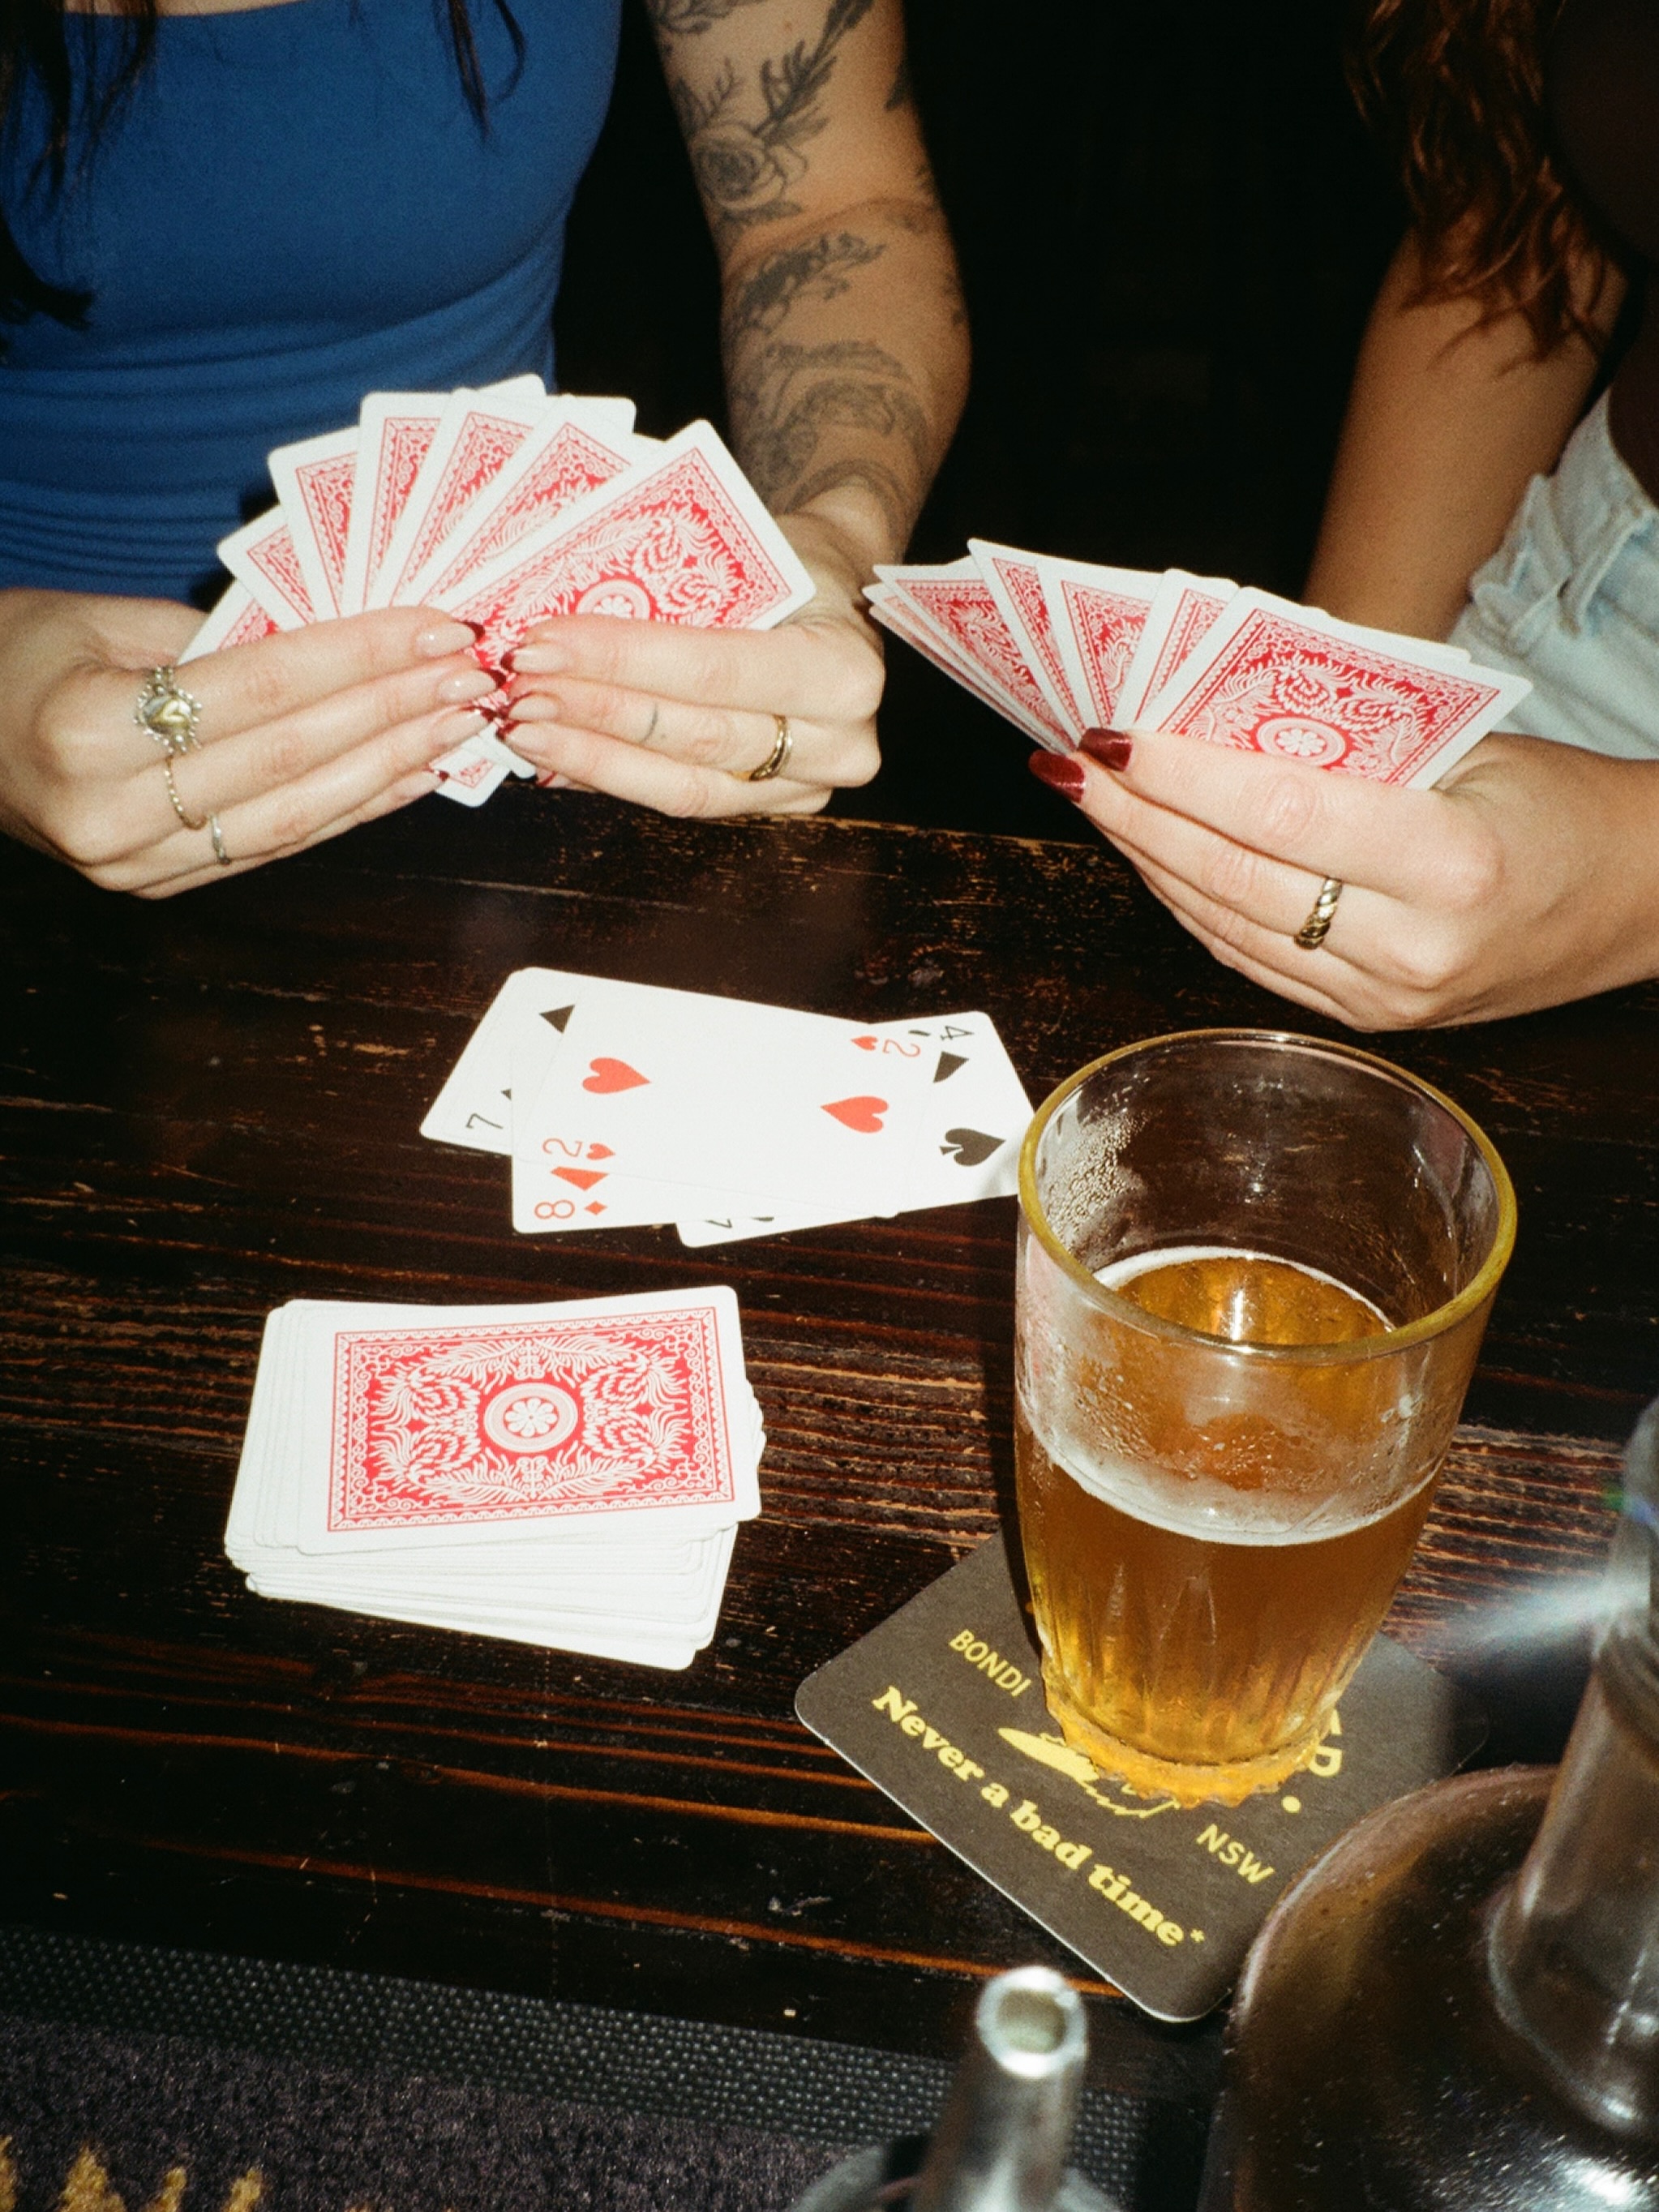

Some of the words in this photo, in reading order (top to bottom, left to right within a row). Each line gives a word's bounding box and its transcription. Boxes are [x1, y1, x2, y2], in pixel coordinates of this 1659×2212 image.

[940, 1025, 975, 1040] 4
[883, 1038, 921, 1057] 2
[465, 1112, 504, 1130] 7
[542, 1138, 583, 1157] 2
[534, 1199, 575, 1220] 8
[949, 1629, 1032, 1697] BONDI
[872, 1685, 984, 1782] Never
[980, 1782, 1010, 1809] a
[1010, 1798, 1093, 1871] bad
[1195, 1823, 1275, 1884] NSW
